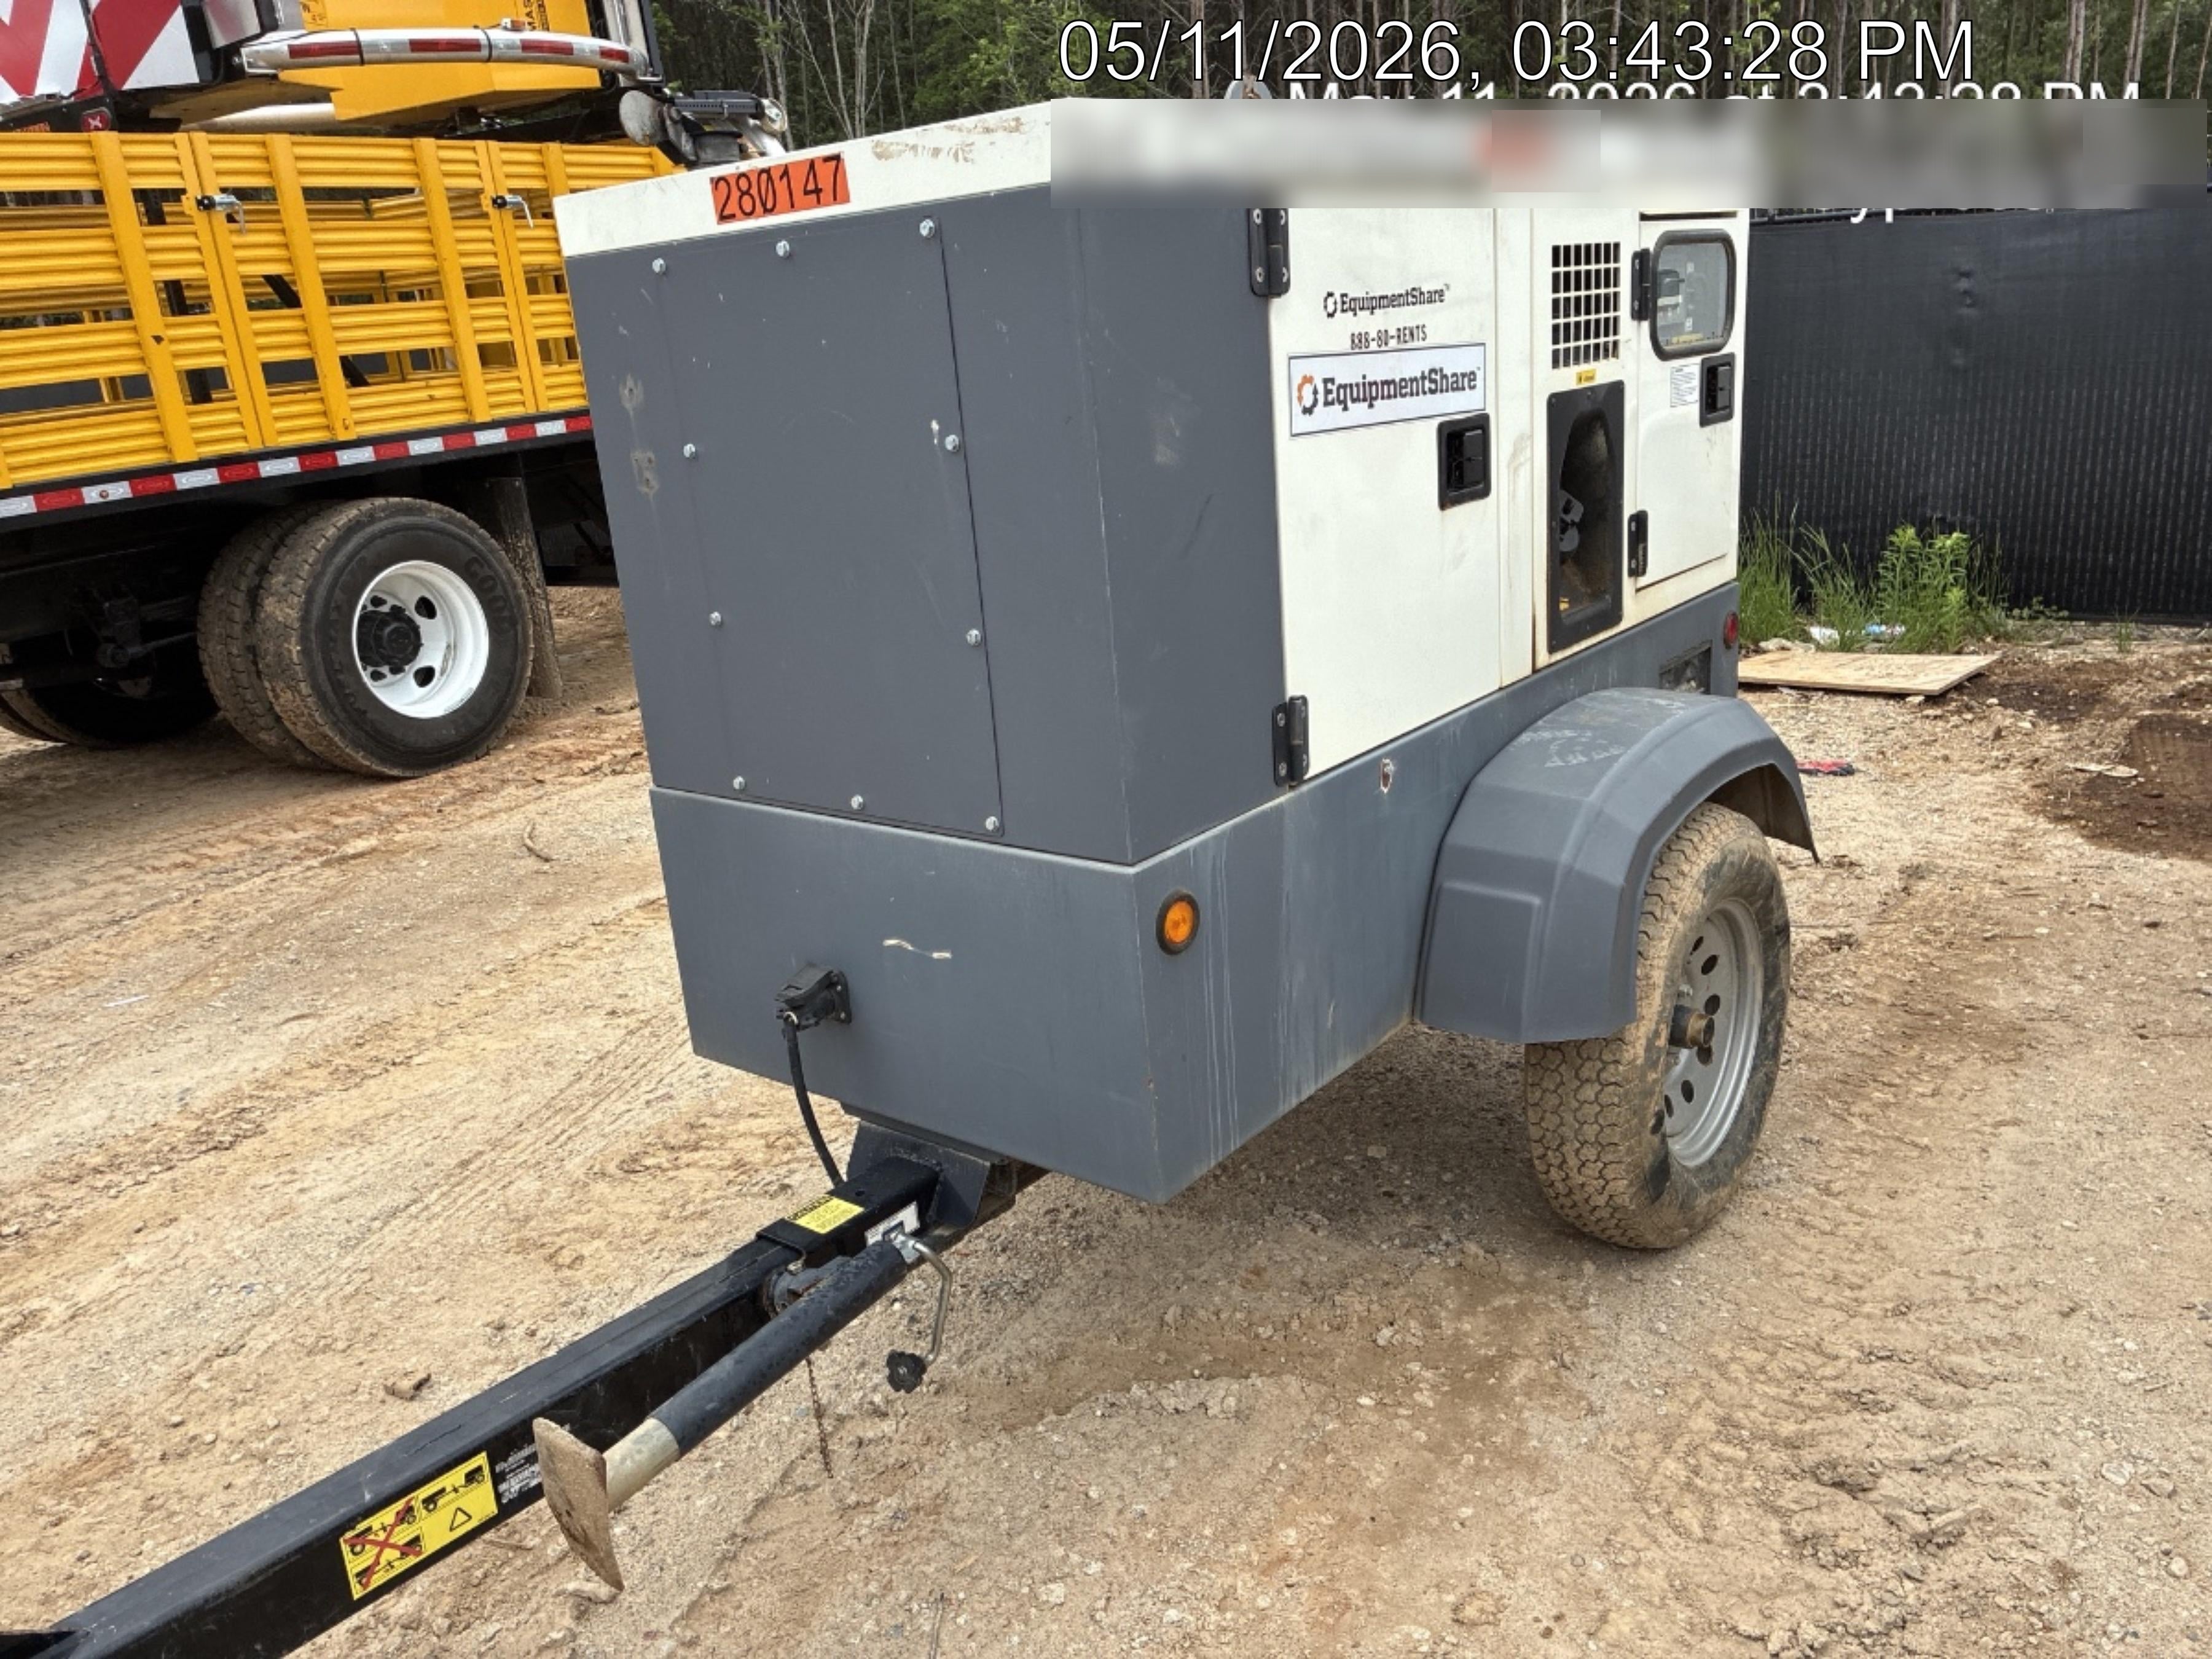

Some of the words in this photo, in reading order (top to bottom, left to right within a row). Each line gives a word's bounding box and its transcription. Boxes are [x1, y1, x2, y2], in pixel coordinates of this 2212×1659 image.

[714, 152, 841, 221] 280147
[1340, 286, 1445, 317] EquipmentShare
[1351, 324, 1427, 350] 888-80-RENTS
[1322, 367, 1477, 412] EquipmentShare
